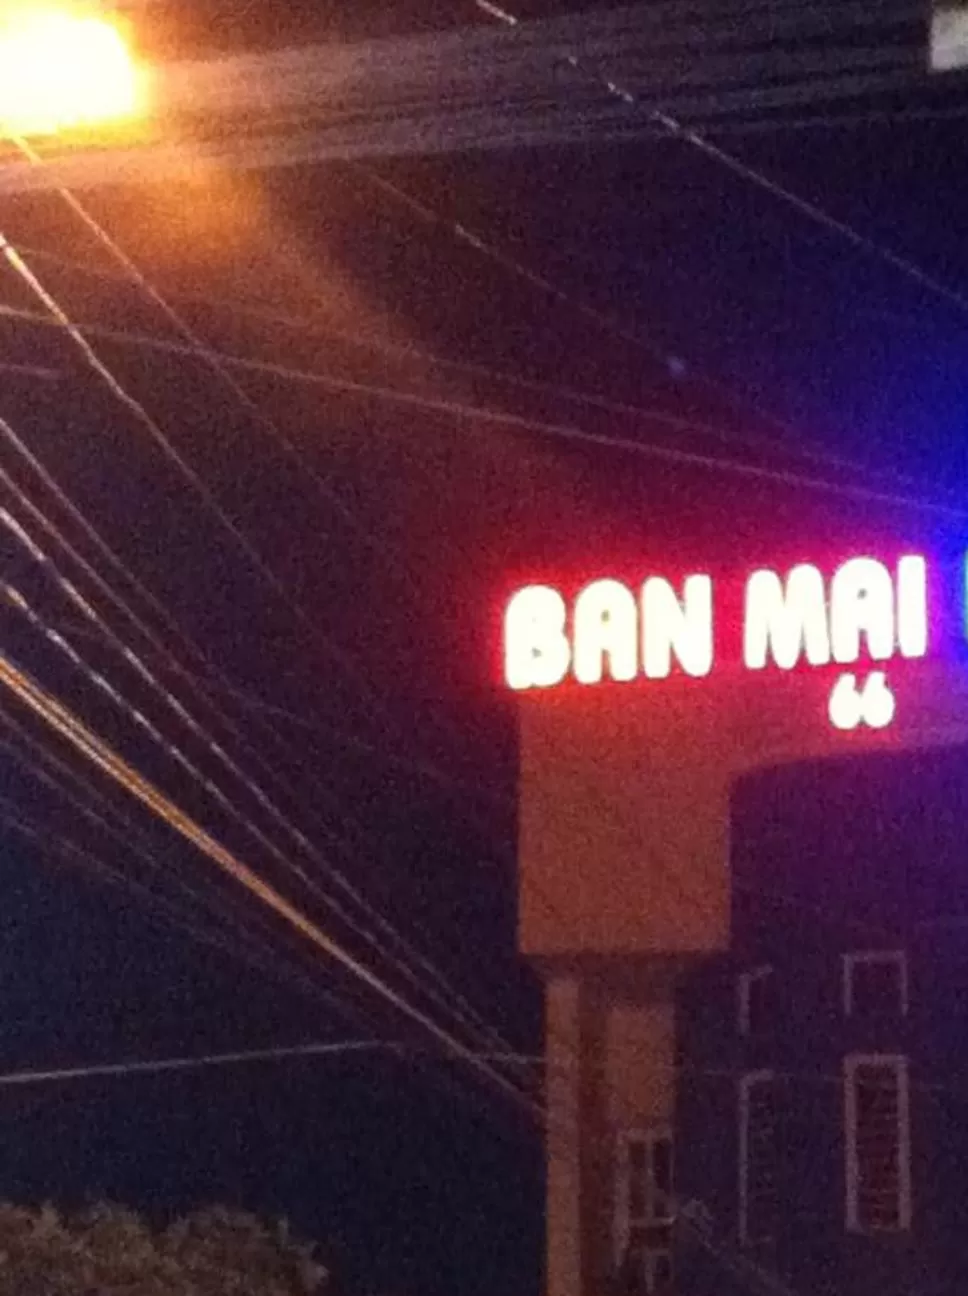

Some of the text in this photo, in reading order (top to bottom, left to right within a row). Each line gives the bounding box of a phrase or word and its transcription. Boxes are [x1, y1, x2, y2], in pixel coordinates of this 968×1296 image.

[504, 574, 713, 690] BAN
[742, 554, 928, 670] MAI
[827, 671, 896, 730] 66
